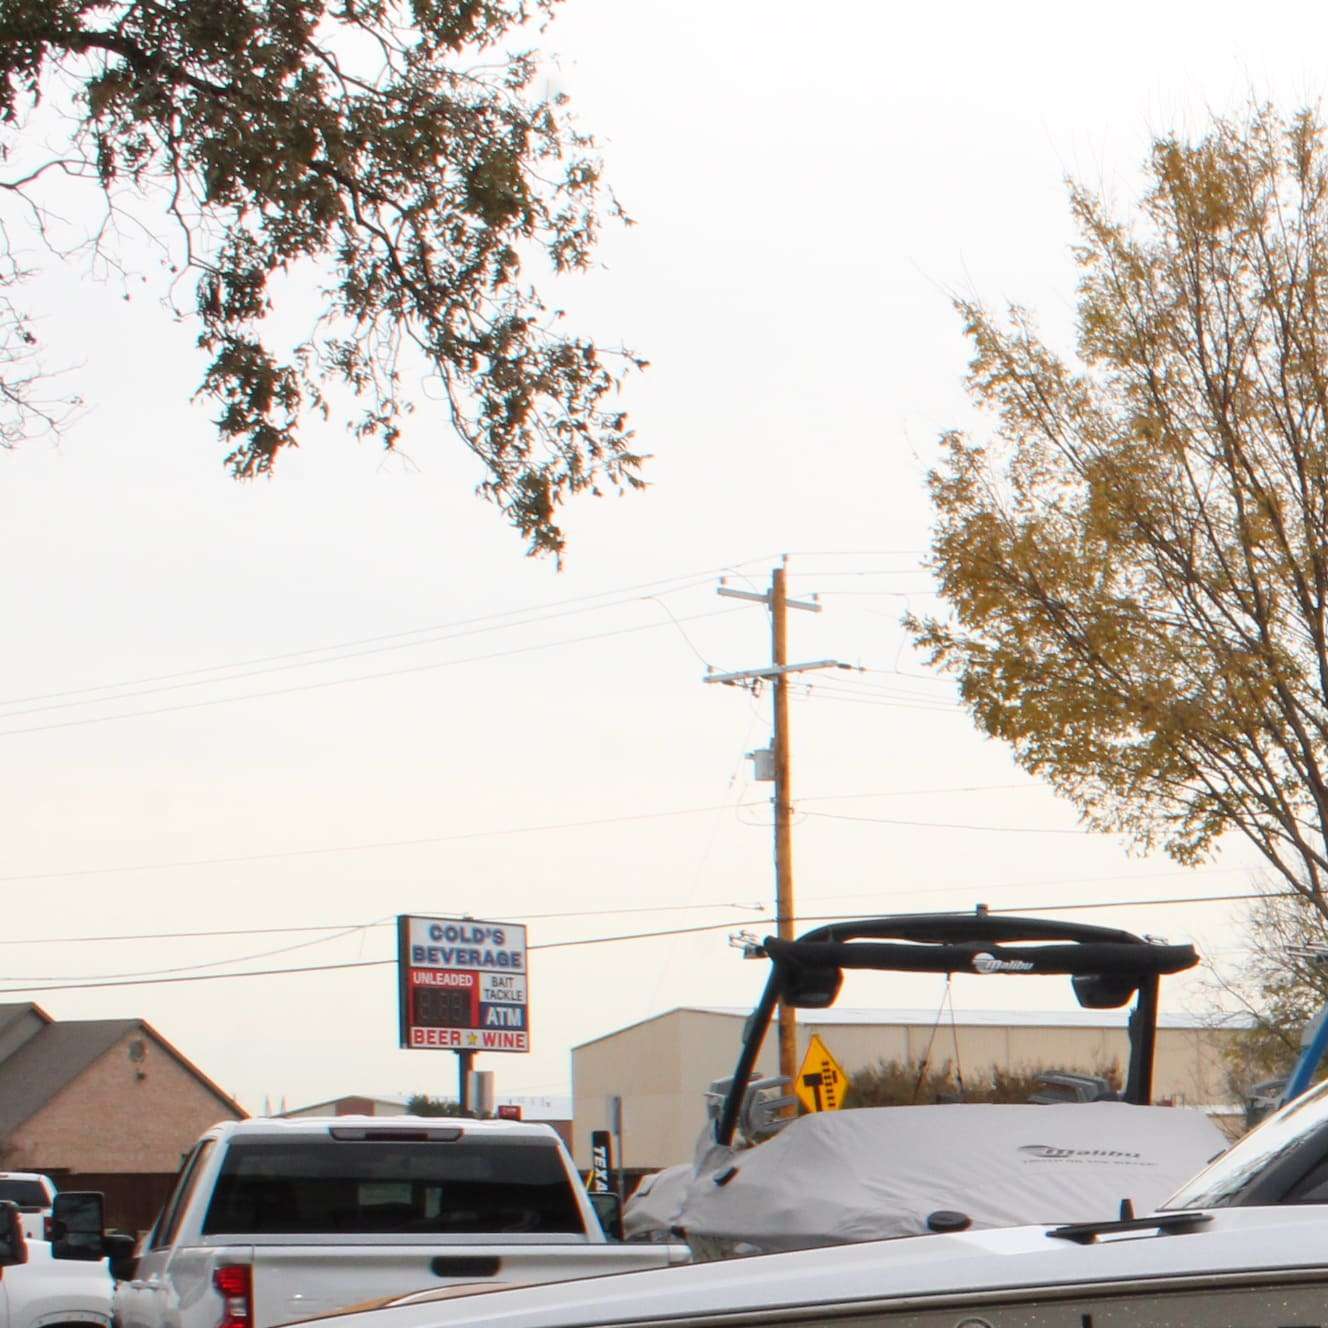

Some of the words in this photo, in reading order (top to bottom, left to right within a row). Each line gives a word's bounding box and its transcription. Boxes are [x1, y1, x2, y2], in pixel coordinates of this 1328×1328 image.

[429, 924, 506, 946] COLD'S
[412, 945, 522, 968] BEVERAGE
[413, 972, 473, 987] UNLEADED
[491, 976, 514, 989] BAIT
[484, 989, 523, 1001] TACKLE
[485, 1006, 523, 1027] ATM
[413, 1029, 461, 1046] BEER
[482, 1032, 526, 1049] WINE
[594, 1145, 609, 1191] TEXA
